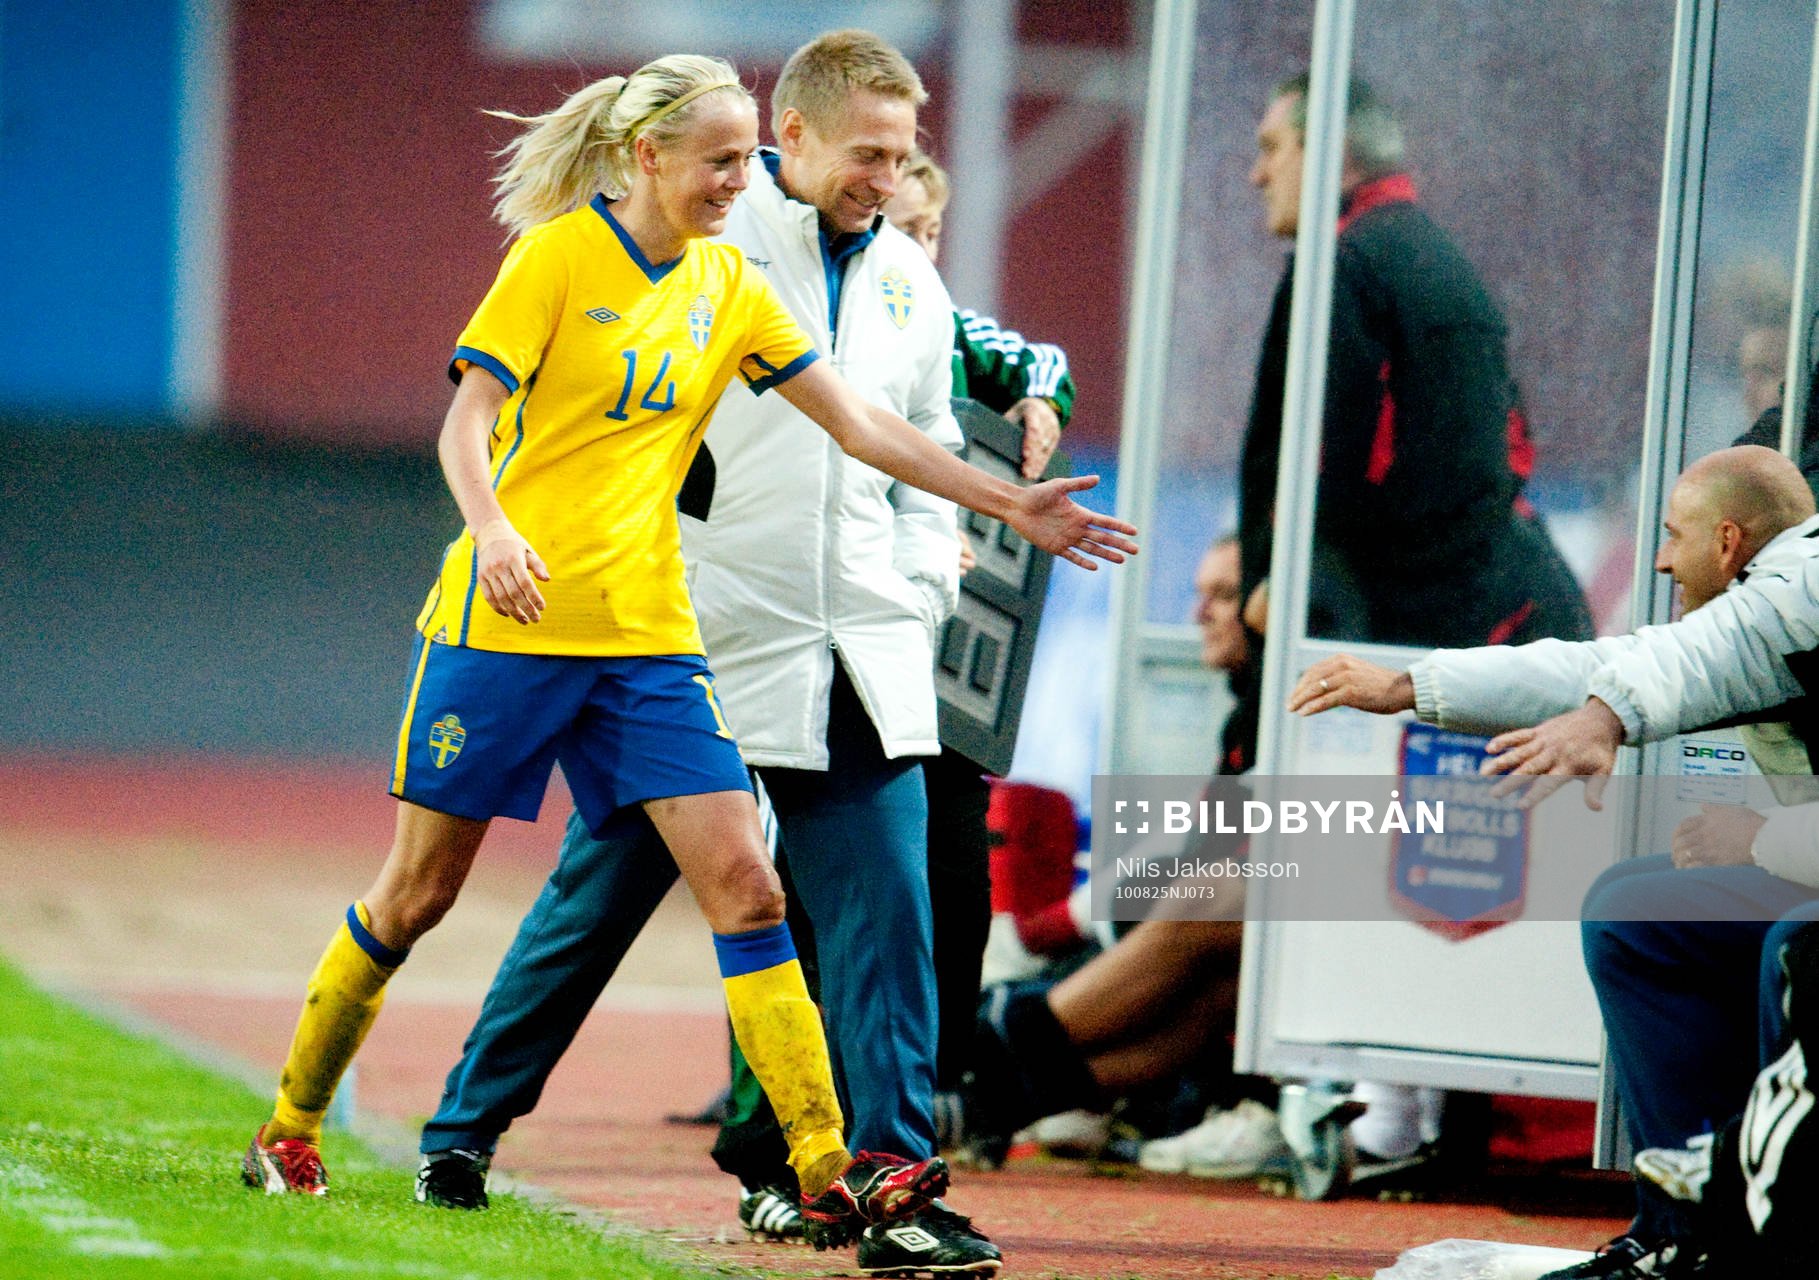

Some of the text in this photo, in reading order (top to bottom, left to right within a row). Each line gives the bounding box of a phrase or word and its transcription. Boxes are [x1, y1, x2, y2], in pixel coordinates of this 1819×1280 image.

[605, 350, 676, 421] 14
[692, 674, 734, 739] 1
[1683, 746, 1746, 761] DACO
